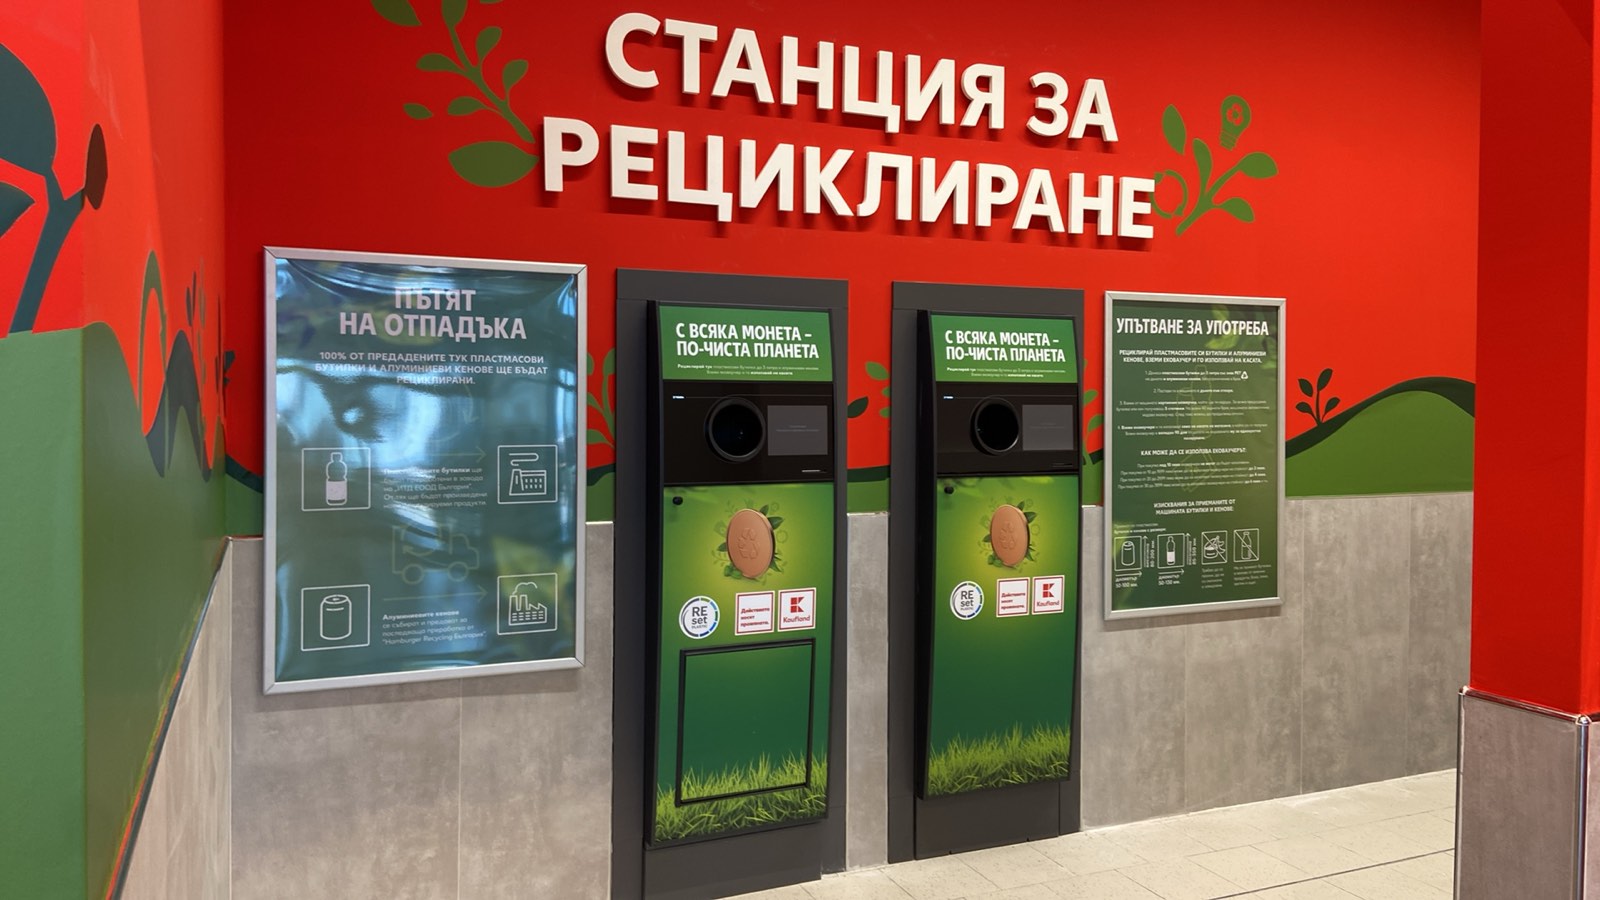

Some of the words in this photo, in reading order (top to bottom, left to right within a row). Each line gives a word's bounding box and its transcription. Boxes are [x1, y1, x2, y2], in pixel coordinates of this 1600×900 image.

[605, 12, 1005, 133] СТАНЦИЯ
[1026, 72, 1118, 142] ЗА
[543, 116, 1155, 238] РЕЦИКЛИРАНЕ
[395, 288, 476, 311] ПЪТЯТ
[340, 312, 377, 336] НА
[384, 313, 527, 343] ОТПАДЪКА
[676, 323, 685, 338] С
[689, 324, 738, 339] ВСЯКА
[742, 324, 802, 341] МОНЕТА
[1116, 318, 1184, 334] УПЪТВАНЕ
[1187, 320, 1202, 334] ЗА
[1206, 320, 1269, 336] УПОТРЕБА
[945, 330, 953, 344] С
[956, 331, 997, 345] ВСЯКА
[1000, 332, 1050, 346] МОНЕТА
[320, 352, 347, 360] 100%
[368, 353, 446, 362] ПРЕДАДЕНИТЕ
[471, 354, 544, 363] ПЛАСТМАСОВИ
[676, 341, 750, 357] ПО-ЧИСТА
[754, 342, 819, 358] ПЛАНЕТА
[946, 346, 1008, 361] ПО-ЧИСТА
[1010, 348, 1066, 362] ПЛАНЕТА
[454, 366, 494, 374] КЕНОВЕ
[496, 366, 512, 375] ЩЕ
[515, 366, 548, 375] БЪДАТ
[961, 590, 974, 599] RE
[692, 606, 708, 617] RE
[692, 616, 708, 625] set
